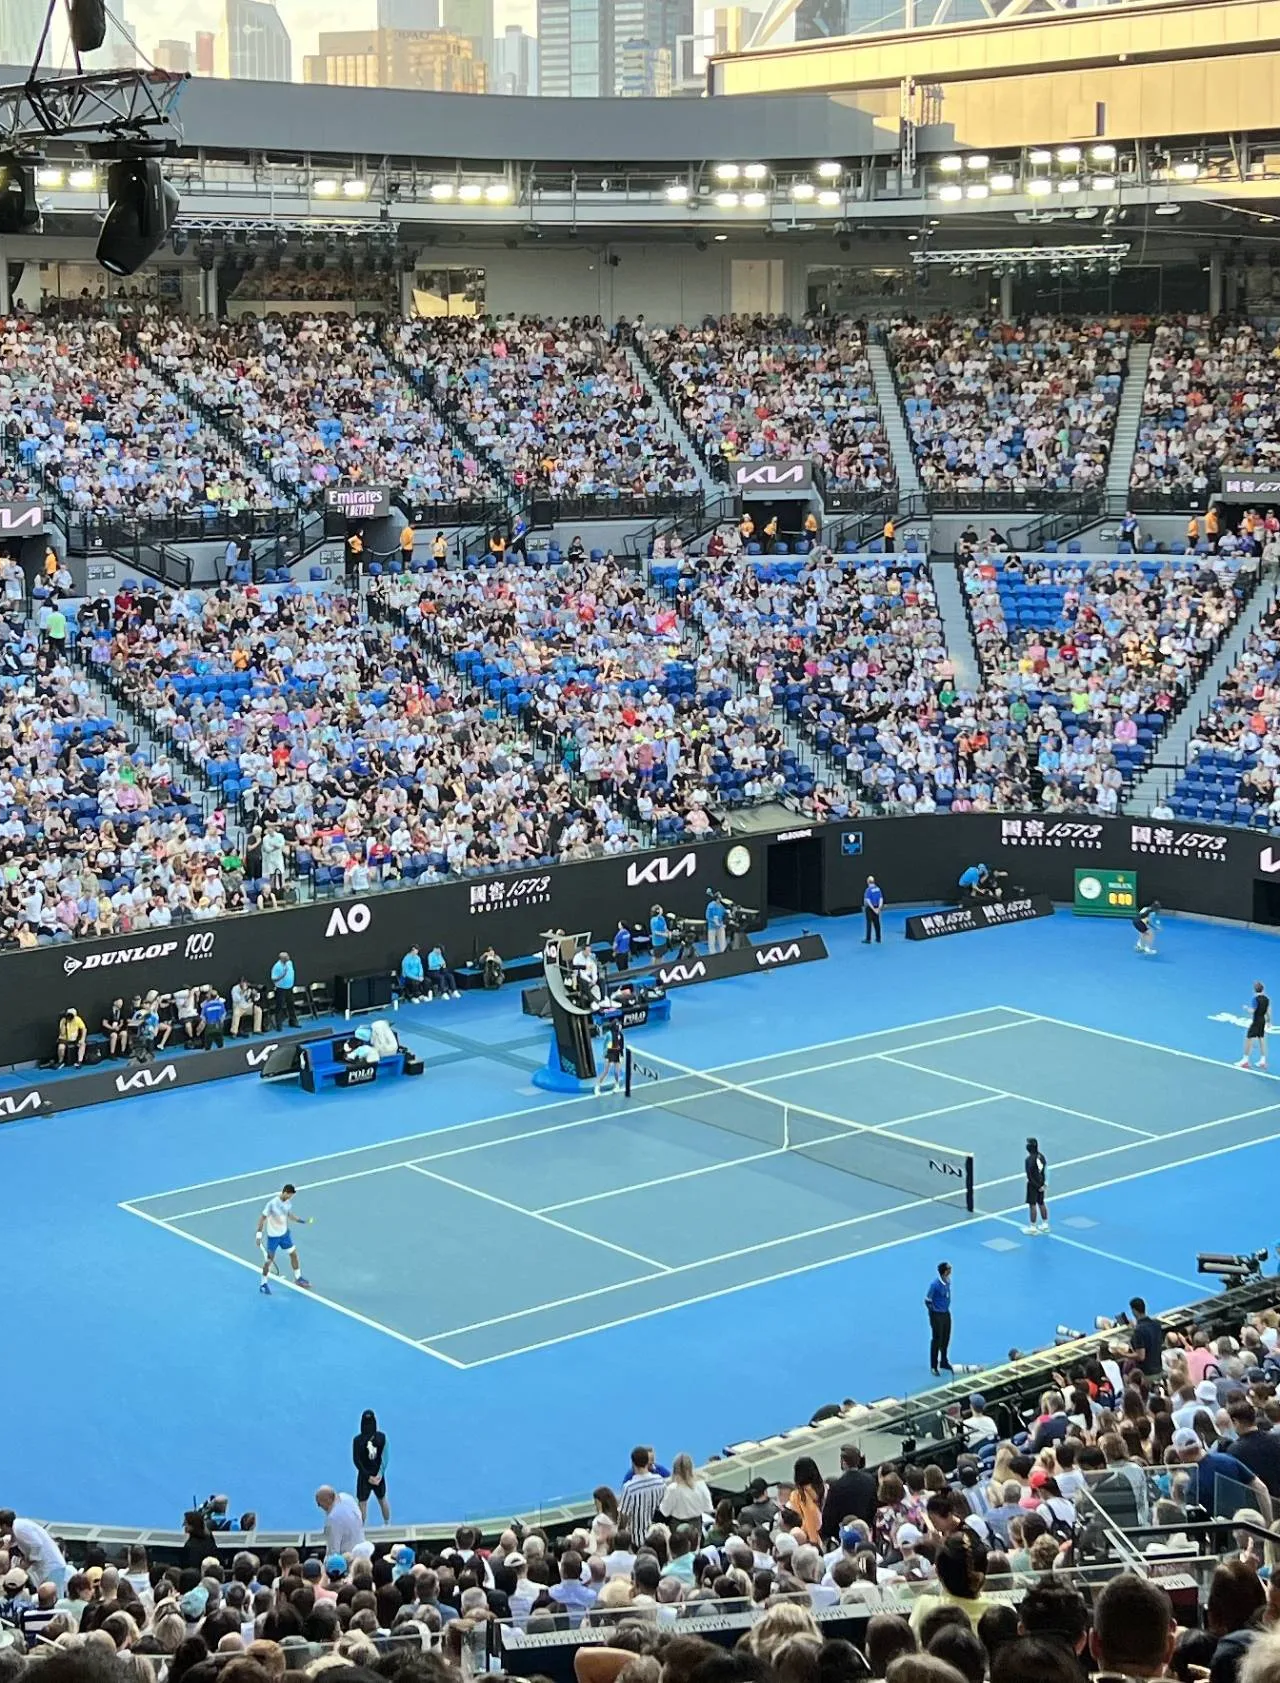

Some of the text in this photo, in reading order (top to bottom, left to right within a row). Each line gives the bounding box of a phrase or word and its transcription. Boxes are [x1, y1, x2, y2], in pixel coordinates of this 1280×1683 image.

[328, 490, 383, 505] Emirates
[325, 903, 371, 937] AO
[82, 932, 215, 969] DUNLOP 100
